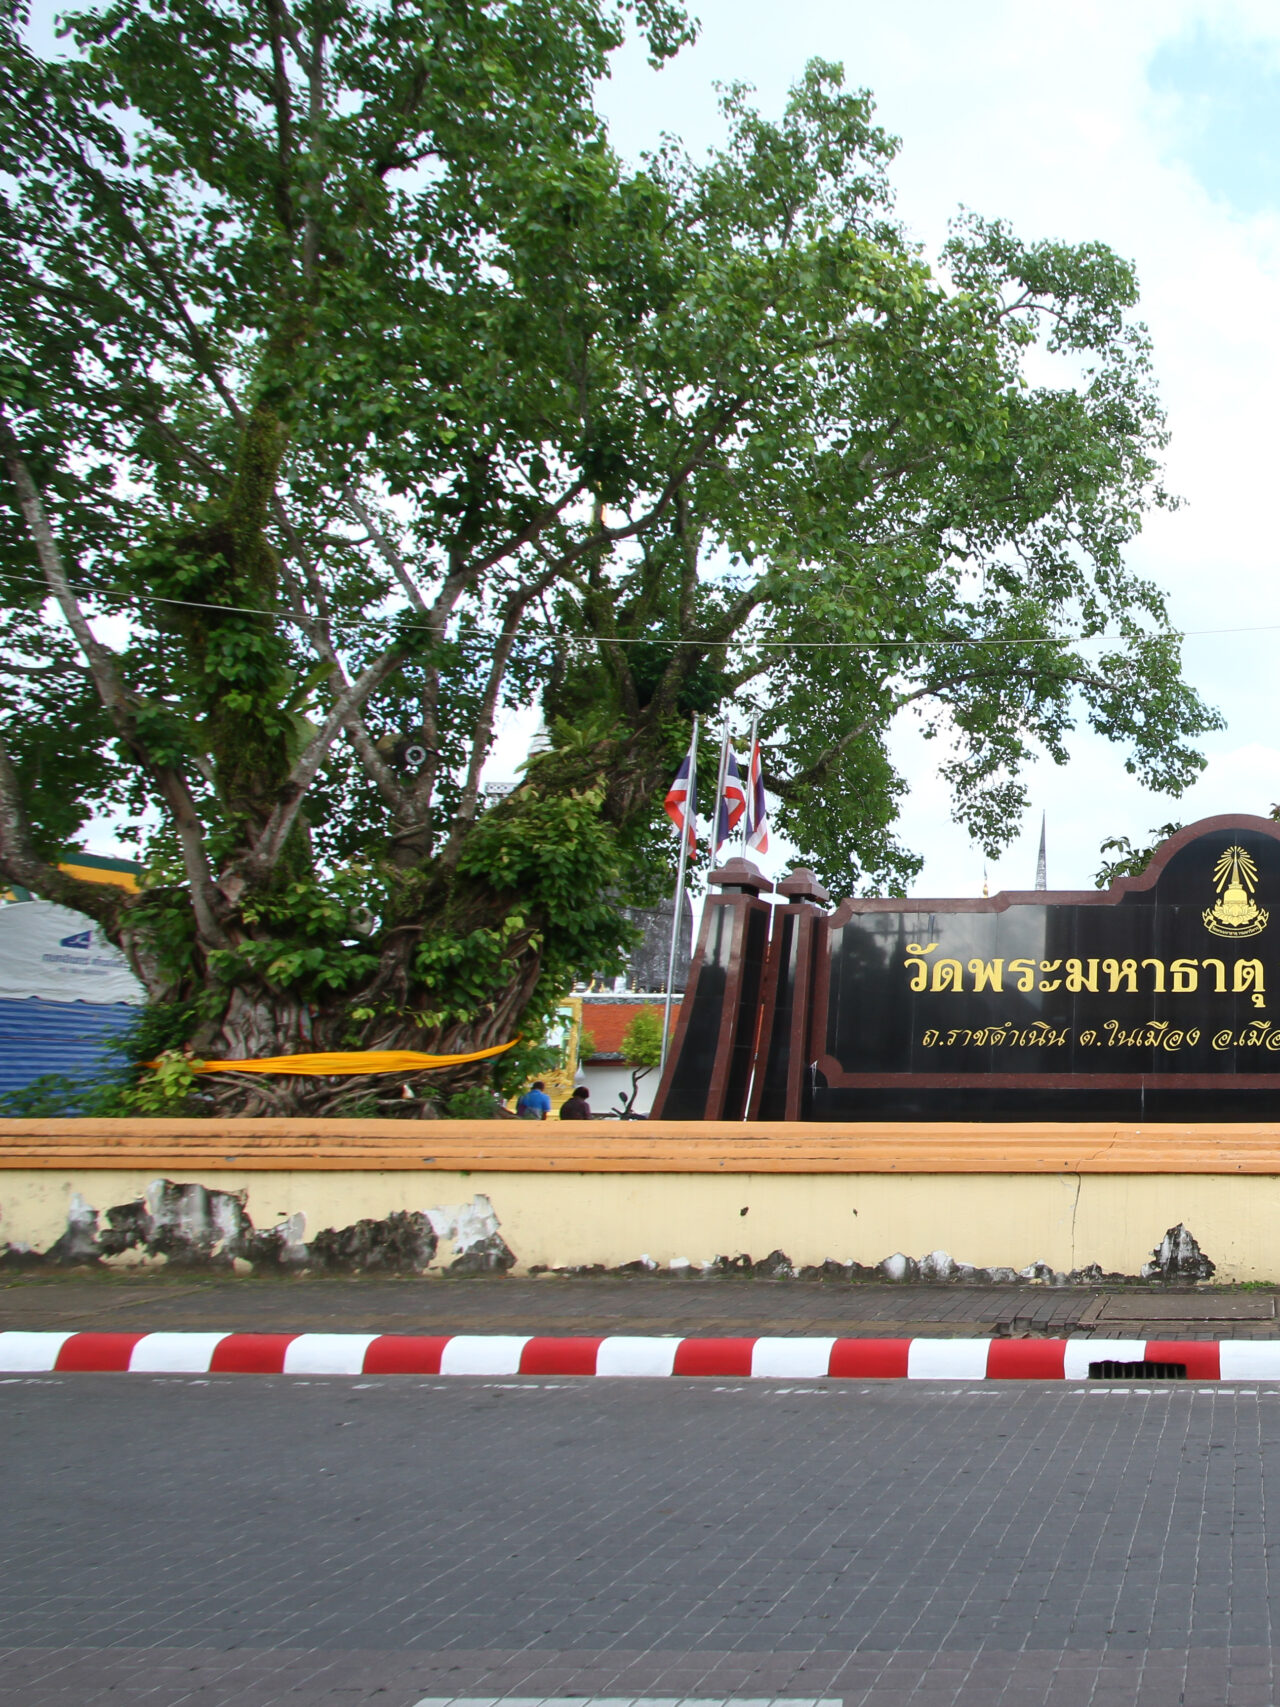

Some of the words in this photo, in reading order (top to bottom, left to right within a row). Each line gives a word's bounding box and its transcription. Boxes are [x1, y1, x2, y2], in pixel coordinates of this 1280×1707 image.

[903, 942, 1267, 1008] วัดพระมหาธาตุ
[921, 1020, 1071, 1048] ถ.ราชดำเนิน
[1079, 1019, 1201, 1052] ต.ในเมือง
